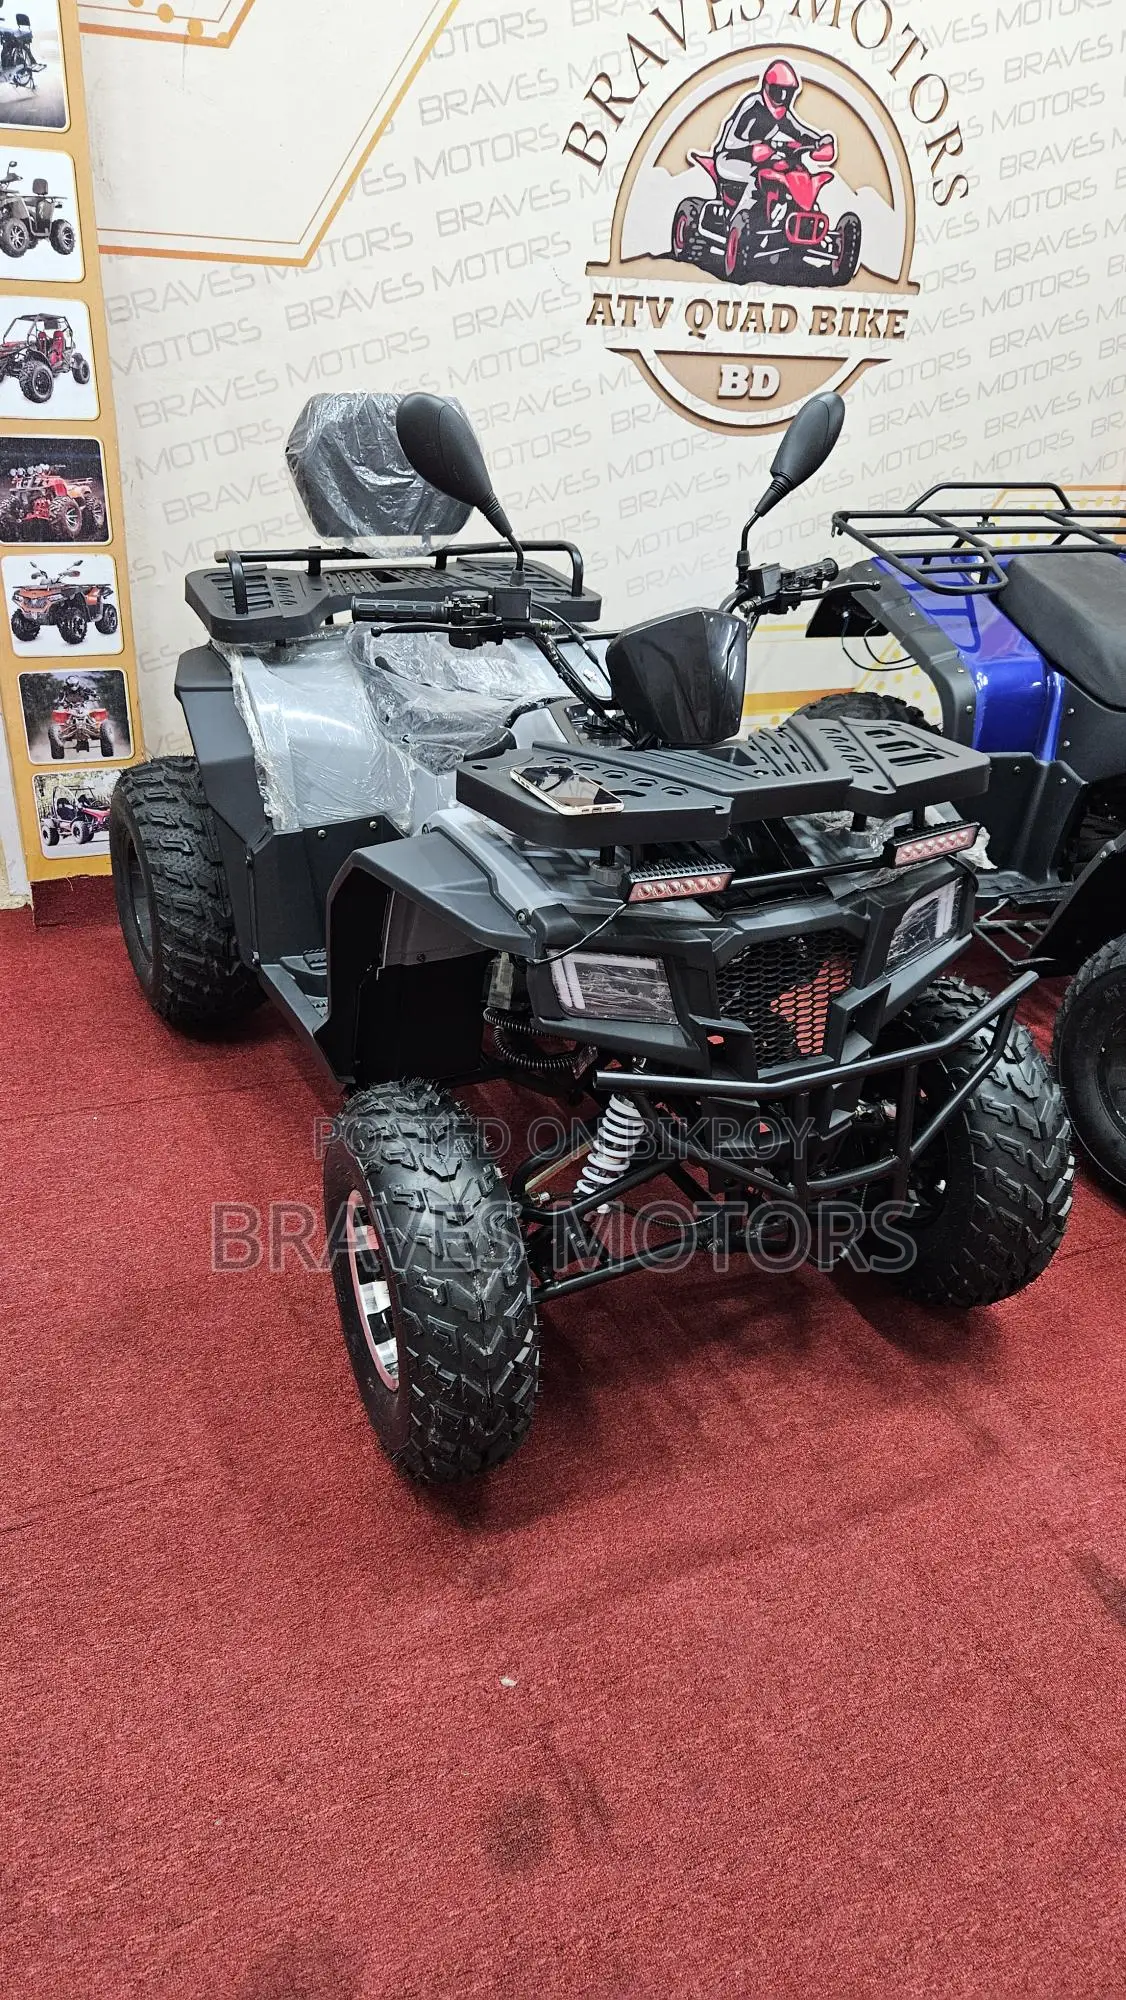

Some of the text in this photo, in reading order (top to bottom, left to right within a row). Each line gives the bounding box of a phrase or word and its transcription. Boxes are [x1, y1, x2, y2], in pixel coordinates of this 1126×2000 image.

[426, 8, 548, 62] OTORS
[1004, 34, 1113, 84] BRAVES
[418, 68, 559, 126] BRAVES
[562, 0, 969, 207] BRAVES MOTORS
[886, 68, 984, 112] OORS
[992, 82, 1105, 134] MOTORS
[414, 122, 560, 184] MOTORS
[999, 131, 1105, 180] BRAVES
[436, 179, 571, 237] BRAVES
[915, 211, 980, 247] AVES
[986, 176, 1098, 228] MOTORS
[994, 222, 1098, 273] BRAVES
[105, 264, 256, 326] BRAVES
[284, 232, 571, 331] BRAVES MOTORS
[982, 265, 1090, 317] MOTORS
[452, 283, 582, 339] BRAVES
[586, 293, 674, 328] ATV
[684, 298, 798, 340] QUAD
[808, 305, 909, 340] BIKE
[989, 308, 1089, 359] BRAVES
[108, 317, 262, 376] MOTORS
[448, 331, 582, 388] MOTORS
[134, 326, 430, 429] BRAVES MOTORS
[717, 364, 781, 399] BD
[862, 347, 971, 400] MOTORS
[868, 387, 970, 436] BRAVES
[978, 350, 1082, 401] MOTORS
[472, 379, 591, 431] BRAVES
[984, 390, 1081, 439] BRAVES
[134, 418, 284, 480] MOTORS
[486, 423, 592, 472] OTORS
[502, 468, 601, 511] RAVES
[606, 431, 727, 482] MOTORS
[861, 429, 968, 480] MOTORS
[972, 428, 1074, 479] MOTORS
[618, 466, 731, 520] BRAVES
[161, 512, 306, 574] MOTORS
[522, 509, 601, 541] TORS
[615, 512, 732, 565] MOTORS
[625, 550, 733, 598] BRAVES
